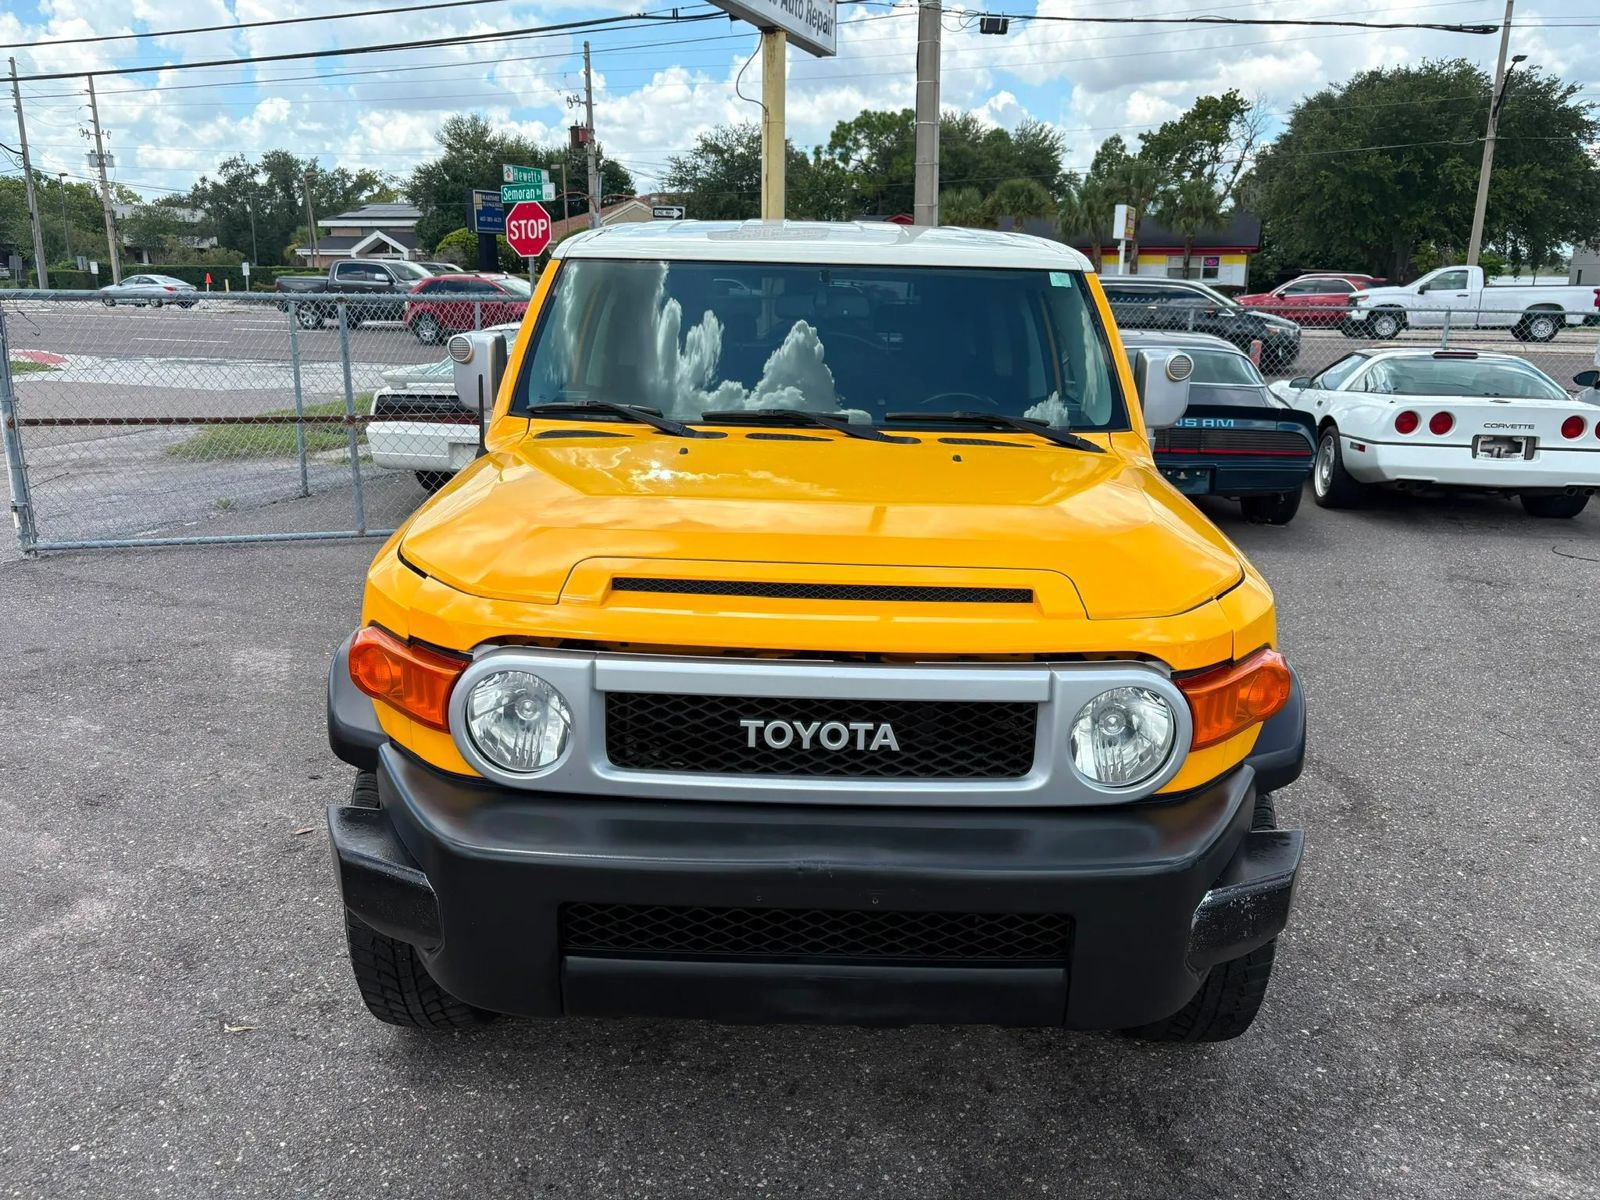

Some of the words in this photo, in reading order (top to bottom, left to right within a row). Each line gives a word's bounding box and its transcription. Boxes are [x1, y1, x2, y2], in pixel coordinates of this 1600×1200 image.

[805, 0, 833, 37] Repair
[513, 168, 537, 183] Hewett
[503, 187, 535, 201] Semoran
[510, 219, 548, 240] STOP
[1175, 418, 1198, 428] CORVETTE
[1202, 418, 1235, 428] AM
[1483, 422, 1535, 430] TOYOTA
